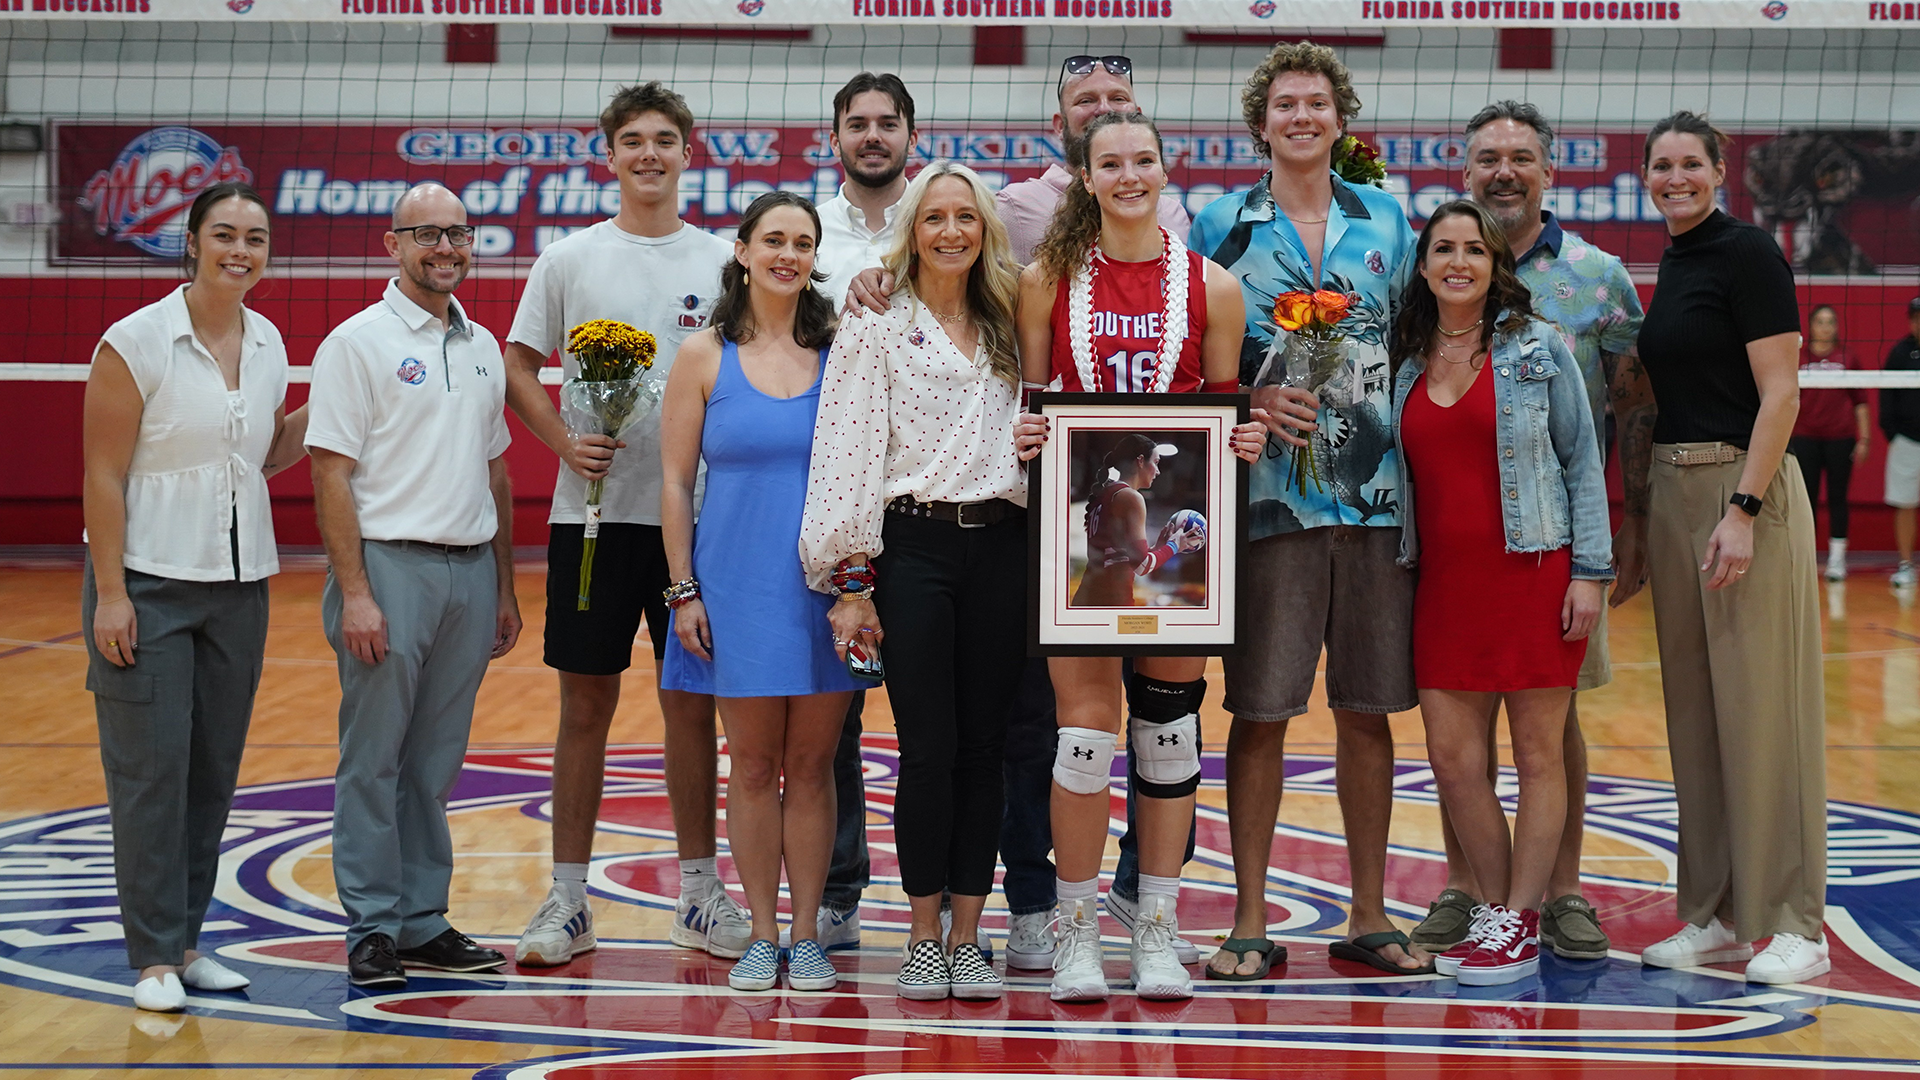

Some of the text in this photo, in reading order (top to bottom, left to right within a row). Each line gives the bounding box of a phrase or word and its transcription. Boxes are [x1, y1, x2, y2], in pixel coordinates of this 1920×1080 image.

[32, 0, 150, 12] MOCCASINS
[341, 0, 662, 15] FLORIDA SOUTHERN MOCCASINS
[853, 0, 1172, 18] FLORIDA SOUTHERN MOCCASINS
[1362, 1, 1680, 20] FLORIDA SOUTHERN MOCCASINS
[402, 132, 613, 162] GEORG
[703, 131, 779, 164] W.
[805, 132, 1066, 166] JNKIN
[84, 147, 253, 235] Mocs
[275, 168, 440, 216] Hom
[460, 166, 531, 216] of
[1106, 350, 1158, 392] 16
